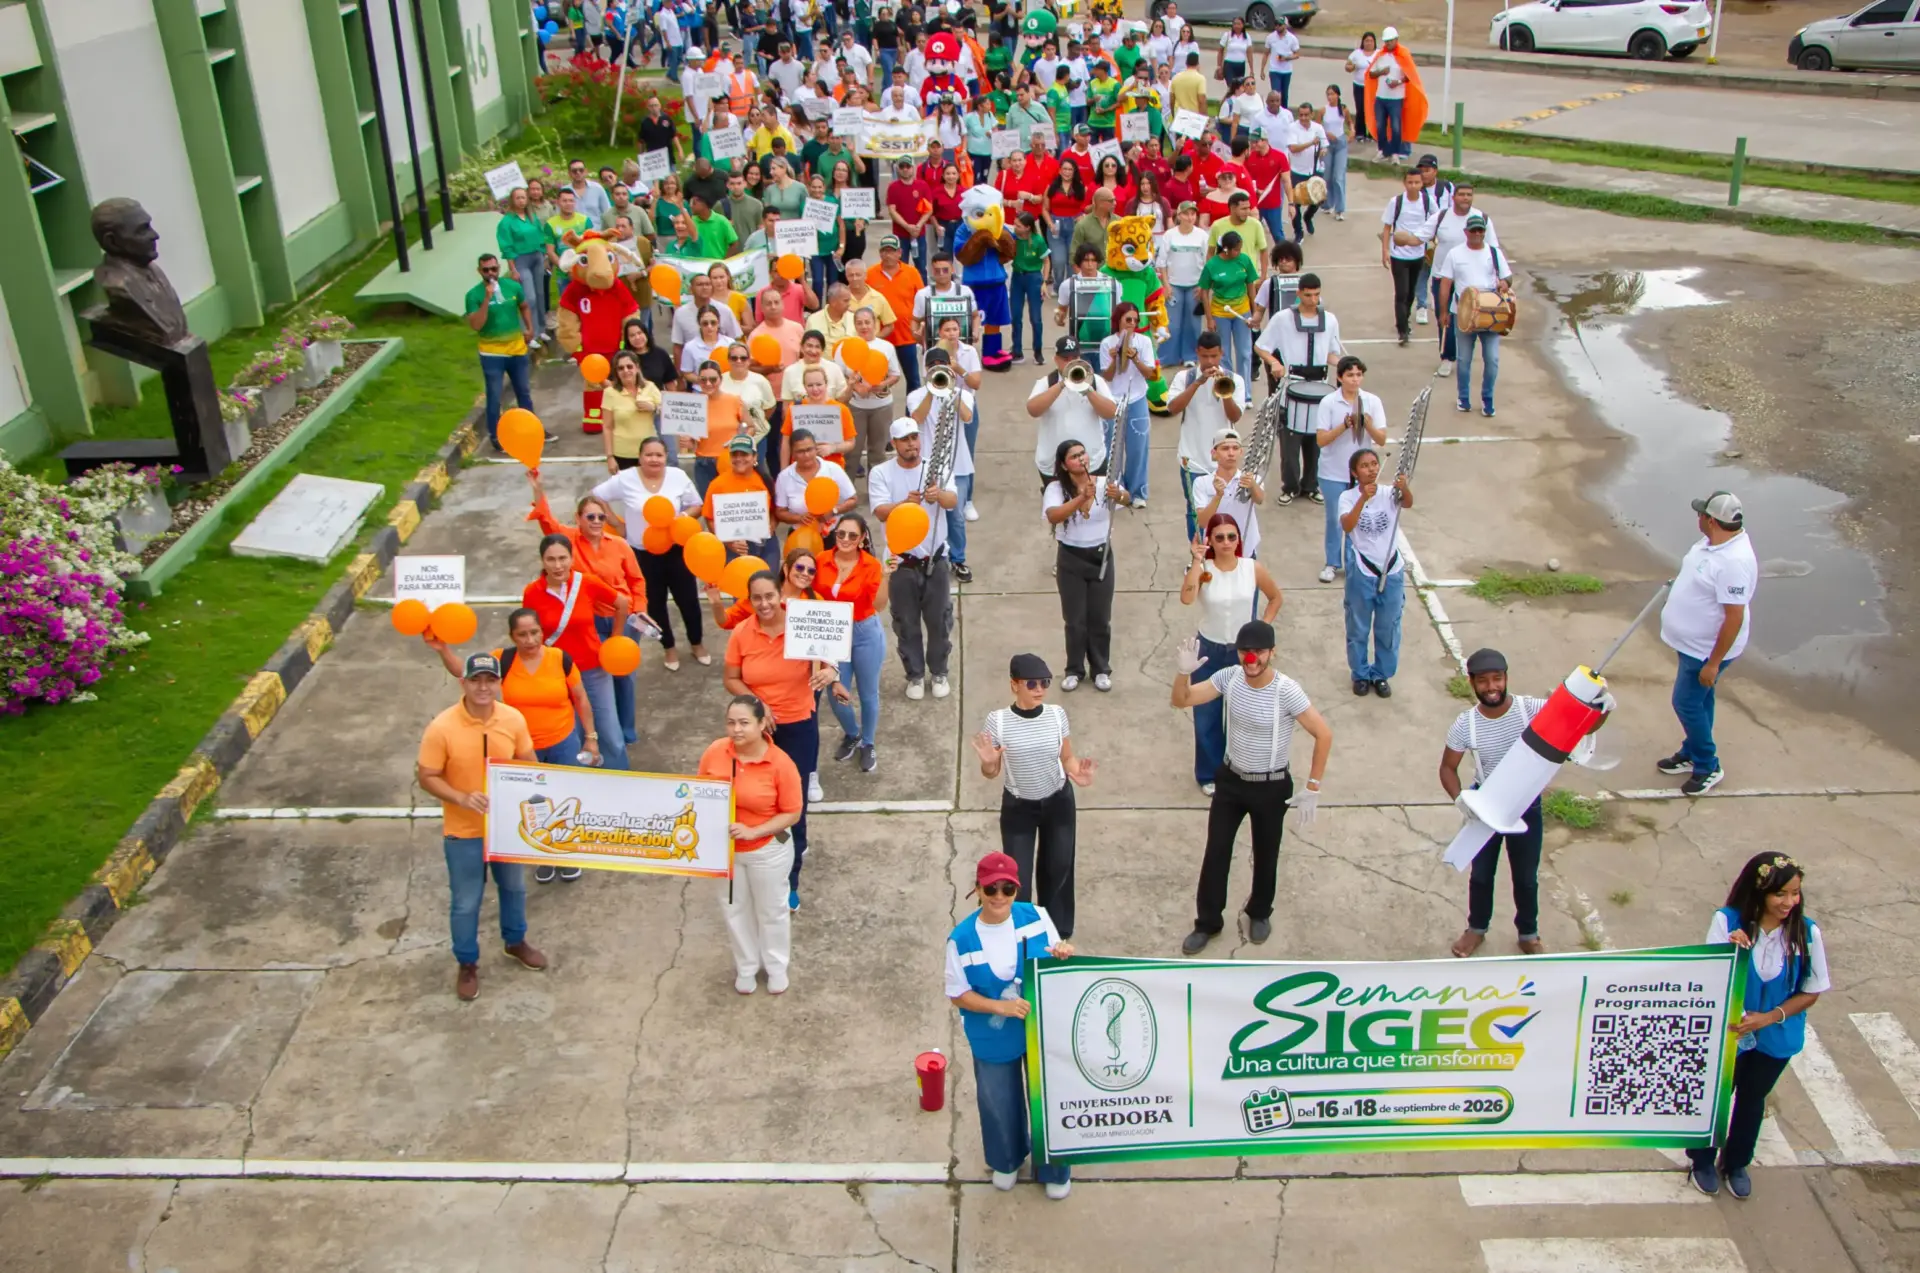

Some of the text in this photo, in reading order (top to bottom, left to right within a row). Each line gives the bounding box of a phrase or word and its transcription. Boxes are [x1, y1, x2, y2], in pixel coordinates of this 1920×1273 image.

[680, 414, 705, 422] CALIDAD
[404, 574, 455, 582] EVALUAMOS
[398, 582, 461, 591] PARA MEJORAR
[789, 616, 834, 625] CONSTRUIMOS
[793, 625, 834, 633] UNIVERSIDAD
[694, 786, 729, 798] SIGEC
[544, 796, 675, 831] Autoevaluación
[566, 827, 672, 848] Acreditación
[577, 845, 647, 857] INSTITUCIONAL
[1606, 982, 1704, 993] Consulta la
[1594, 997, 1716, 1010] Programación
[1229, 1006, 1530, 1054] SIGEC
[1228, 1050, 1515, 1073] Una cultura que transforma
[1060, 1095, 1174, 1110] UNIVERSIDAD DE
[1298, 1099, 1504, 1118] Del 16 al 18 de septiembre de 2026
[1061, 1109, 1174, 1130] CÓRDOBA
